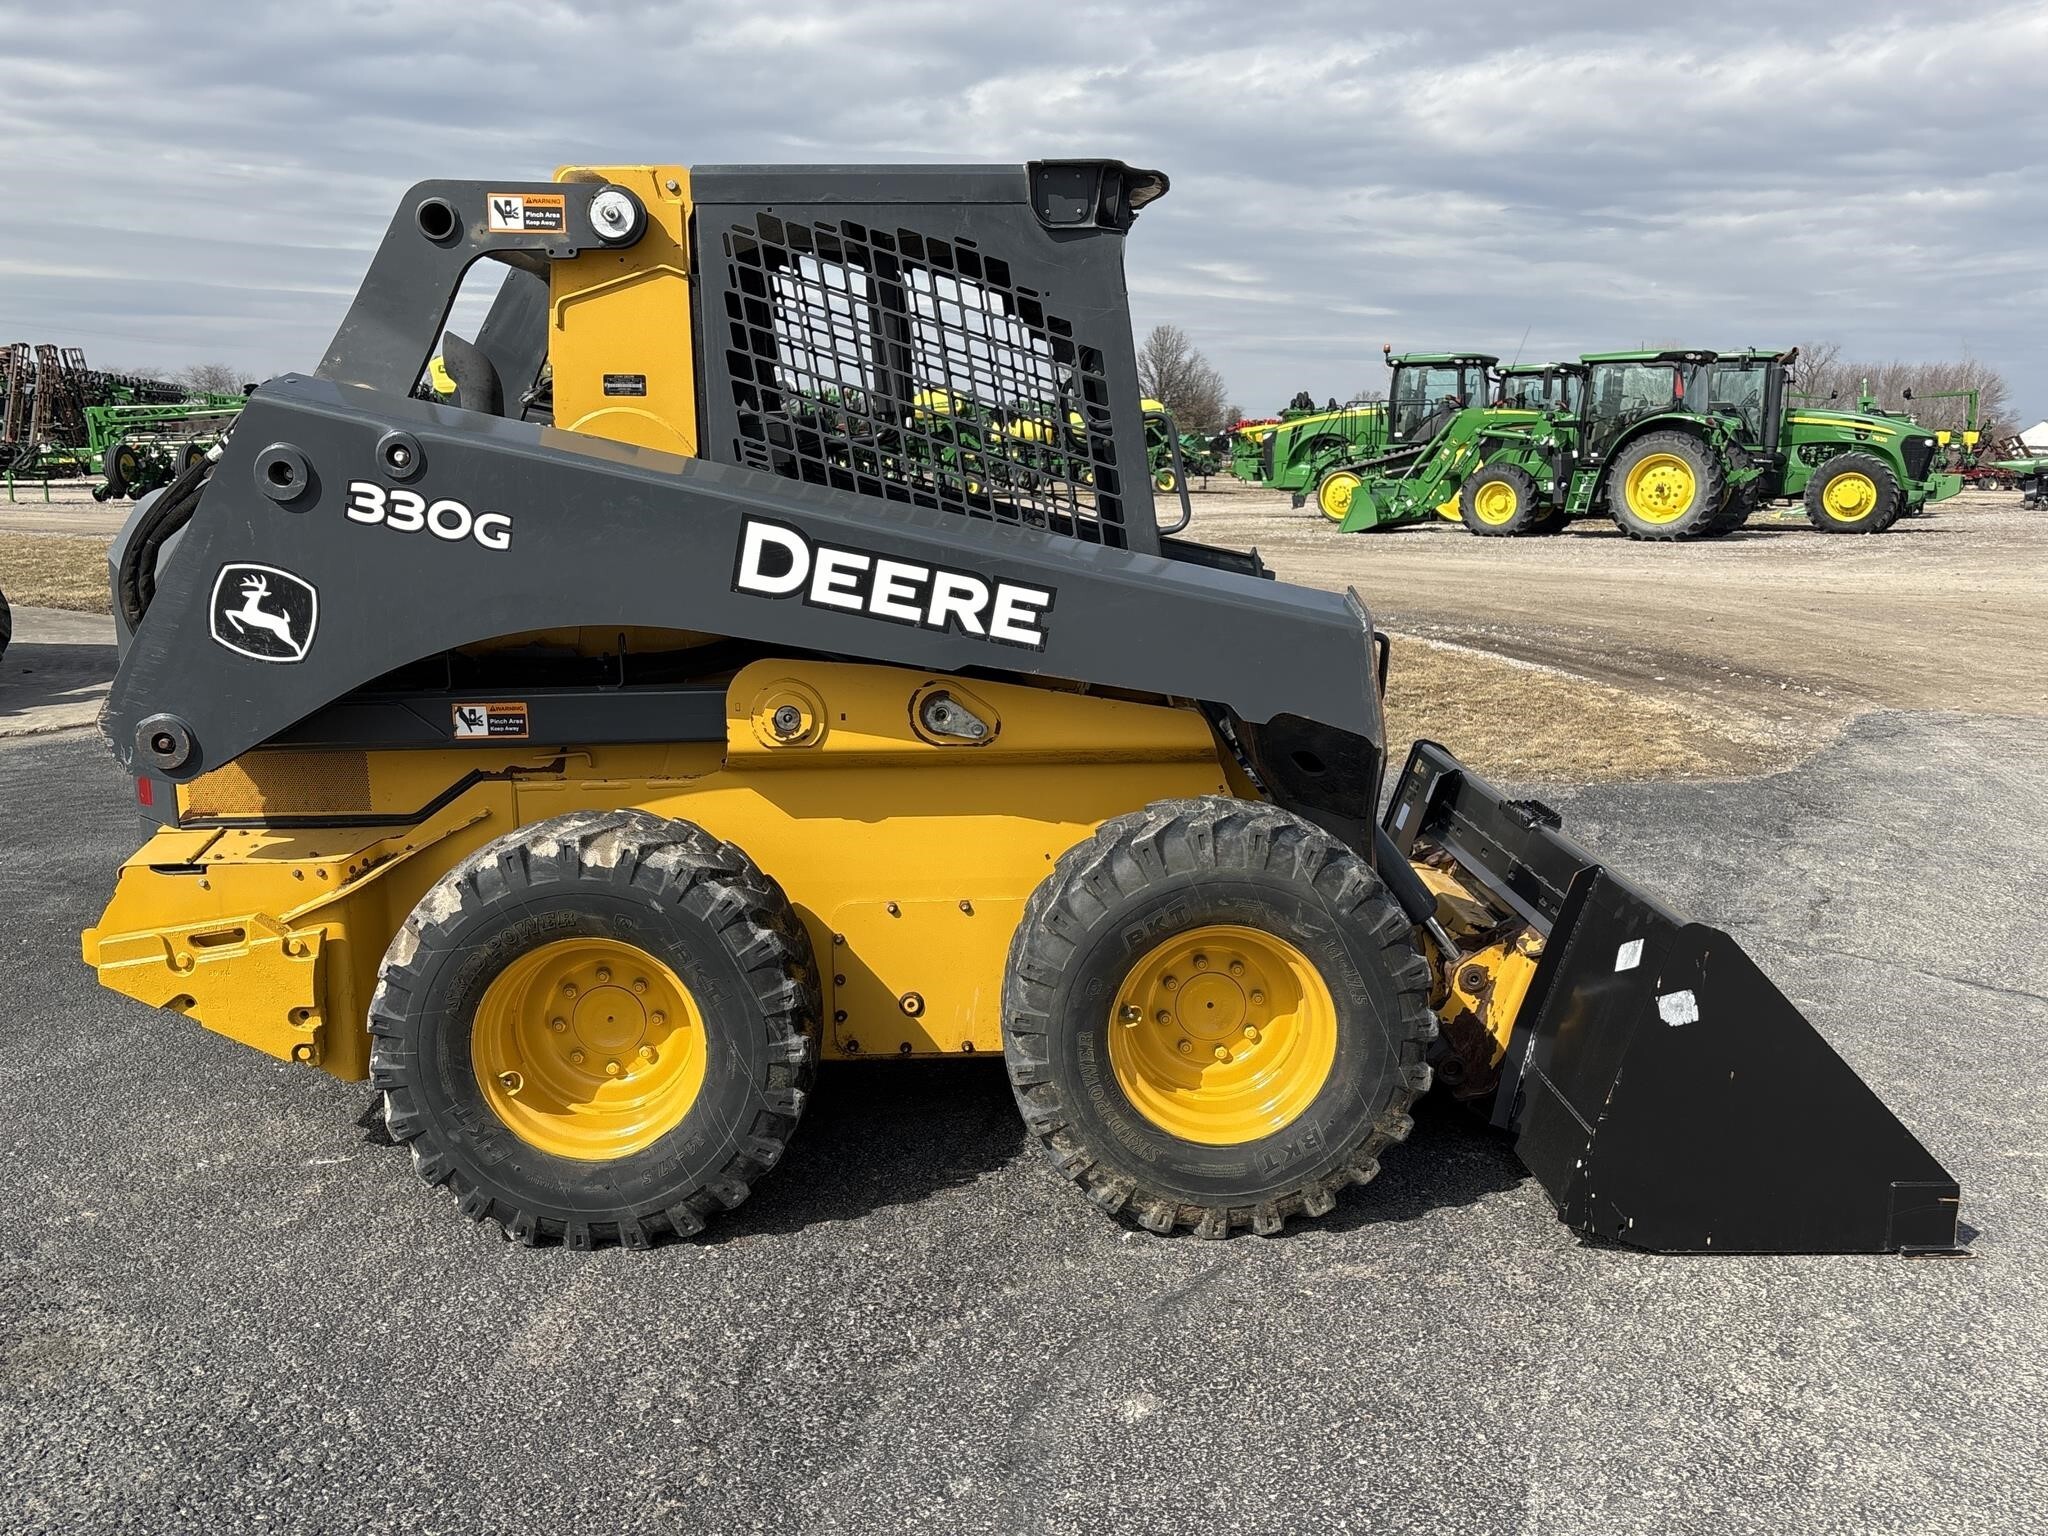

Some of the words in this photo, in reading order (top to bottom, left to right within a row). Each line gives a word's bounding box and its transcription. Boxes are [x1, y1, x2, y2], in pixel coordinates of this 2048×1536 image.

[347, 482, 512, 550] 330G
[737, 520, 1050, 646] DEERE
[486, 909, 577, 958] POWER
[1122, 899, 1191, 950] BKT
[1076, 1030, 1113, 1119] POWER
[1259, 1121, 1325, 1177] BKT
